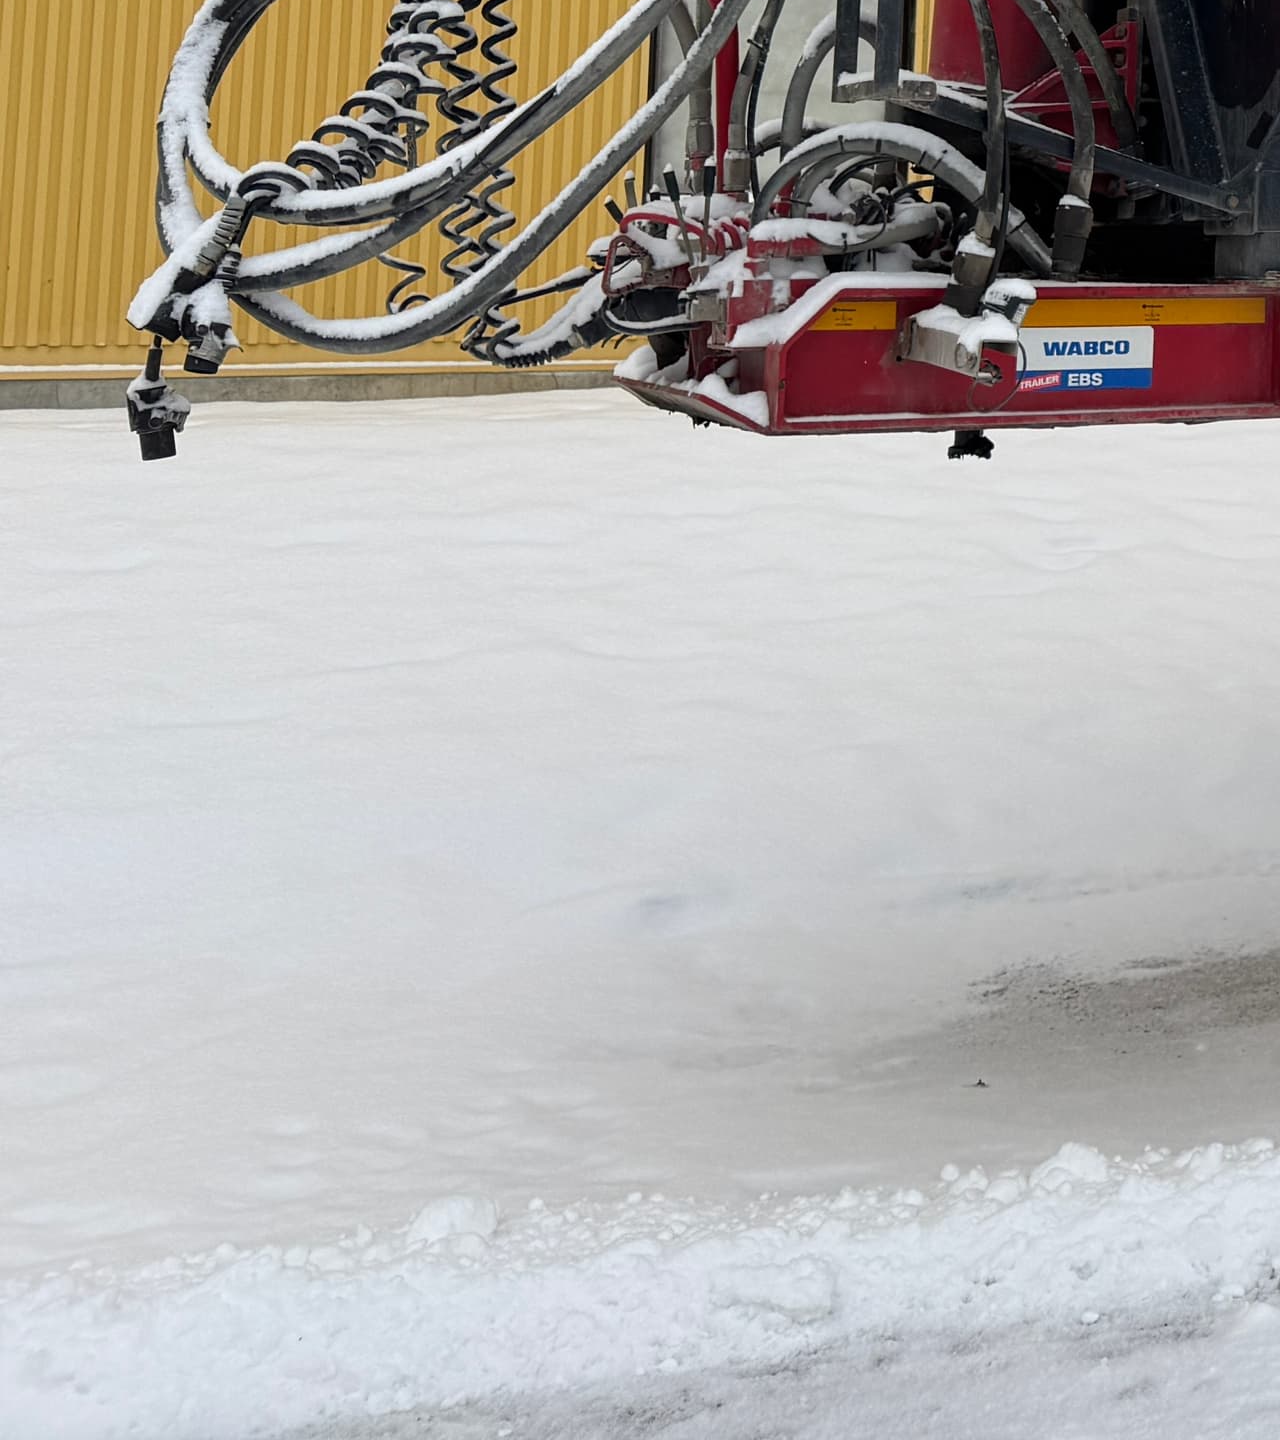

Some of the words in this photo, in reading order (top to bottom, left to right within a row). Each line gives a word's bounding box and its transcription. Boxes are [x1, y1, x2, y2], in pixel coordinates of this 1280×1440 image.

[1043, 340, 1130, 357] WABCO
[1020, 375, 1060, 390] TRAILER
[1067, 373, 1103, 387] EBS
